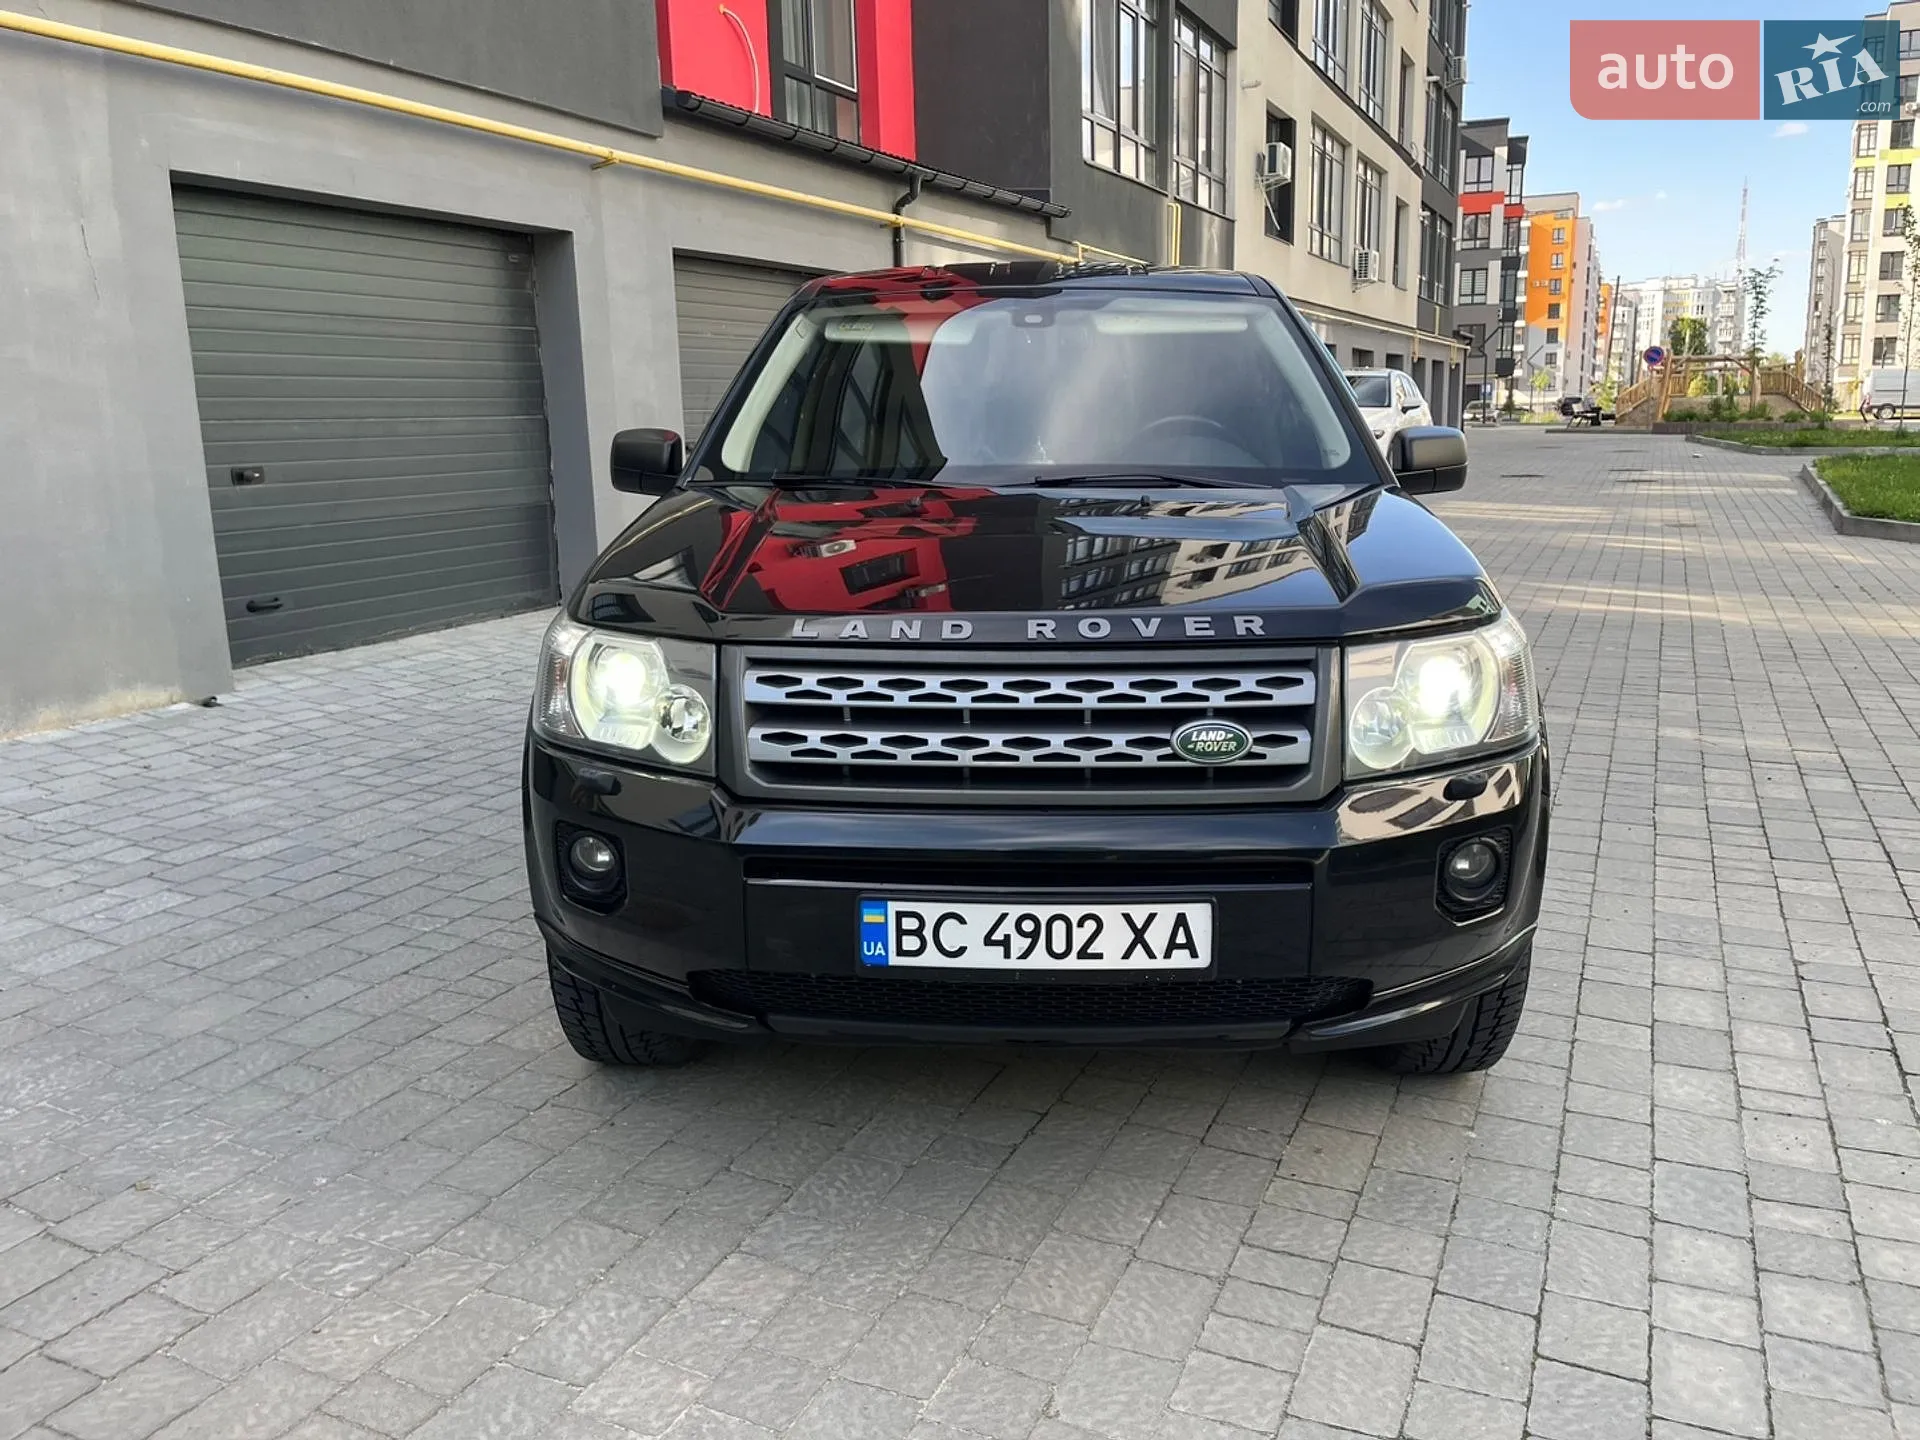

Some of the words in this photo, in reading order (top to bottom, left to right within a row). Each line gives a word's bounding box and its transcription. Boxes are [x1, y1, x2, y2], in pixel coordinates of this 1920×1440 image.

[791, 617, 974, 640] LAND
[1027, 615, 1266, 639] ROVER
[1191, 730, 1226, 741] LAND
[1194, 741, 1237, 752] ROVER
[895, 910, 968, 959] BC
[983, 912, 1104, 960] 4902
[1120, 911, 1200, 960] XA
[863, 941, 886, 956] UA
